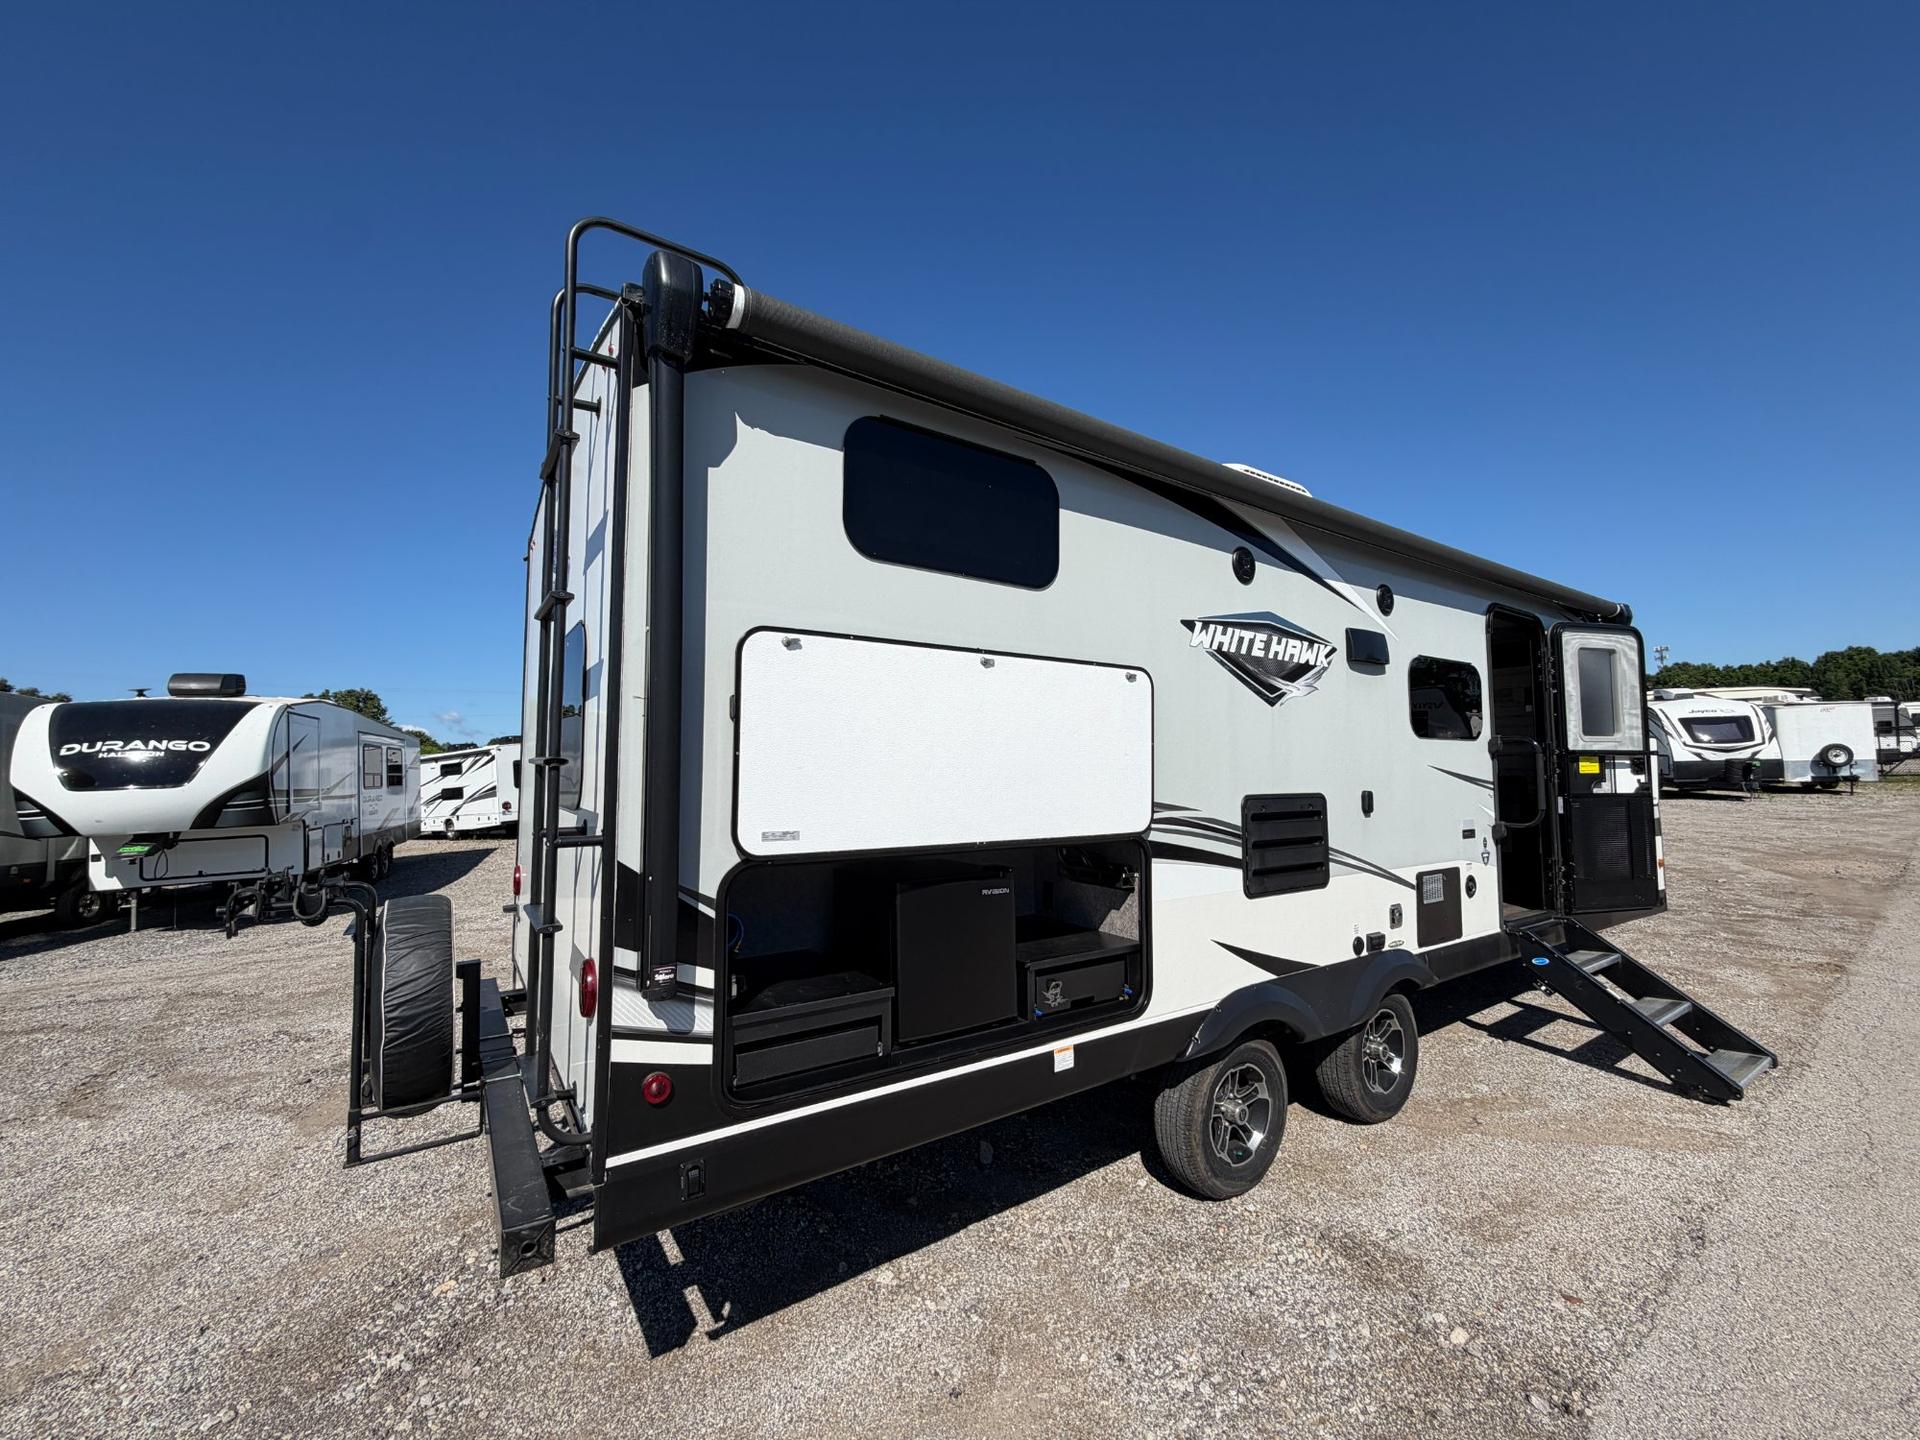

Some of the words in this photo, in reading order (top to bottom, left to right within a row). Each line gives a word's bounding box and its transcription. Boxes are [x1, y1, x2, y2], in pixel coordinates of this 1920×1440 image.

[1189, 621, 1268, 657] WHITE
[1268, 635, 1333, 667] HAWK
[59, 740, 211, 756] DURANGO
